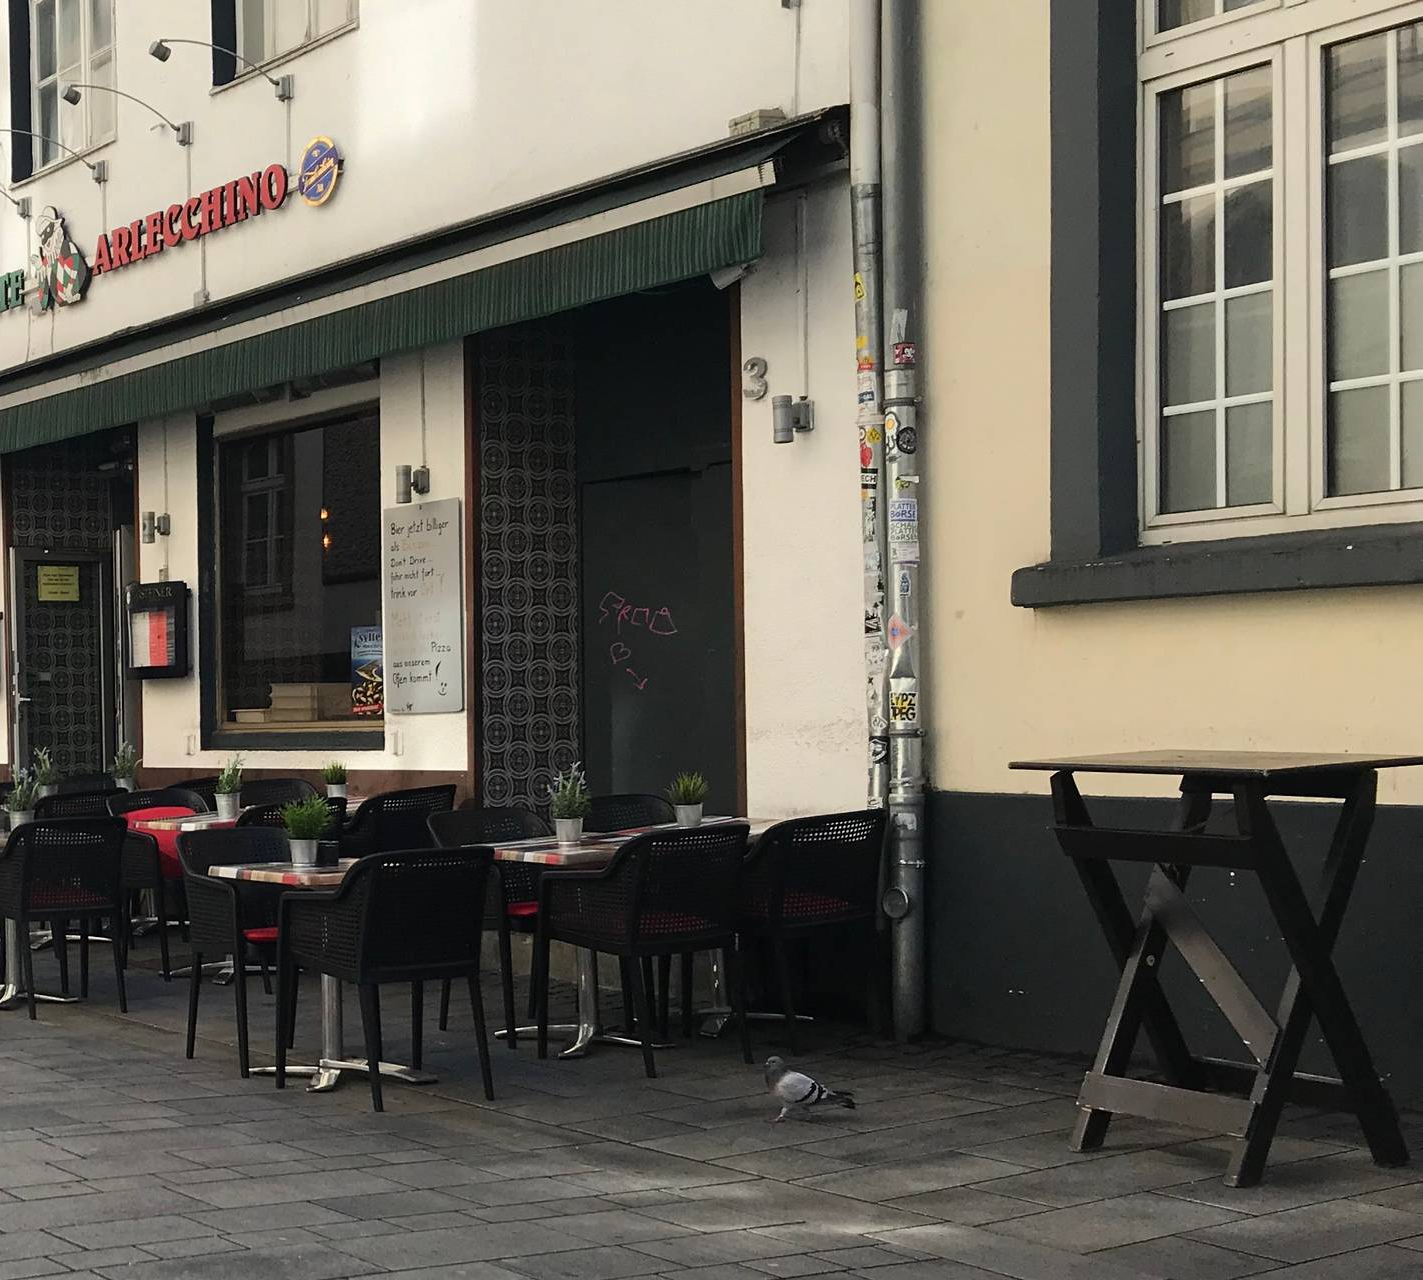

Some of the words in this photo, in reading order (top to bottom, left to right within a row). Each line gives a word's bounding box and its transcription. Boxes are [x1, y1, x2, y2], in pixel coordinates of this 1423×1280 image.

[93, 164, 288, 276] ARLECCHINO
[743, 357, 768, 401] 3
[390, 522, 405, 535] Bier
[406, 519, 424, 538] jetzt
[426, 517, 449, 536] billiger
[431, 641, 452, 652] Pizza
